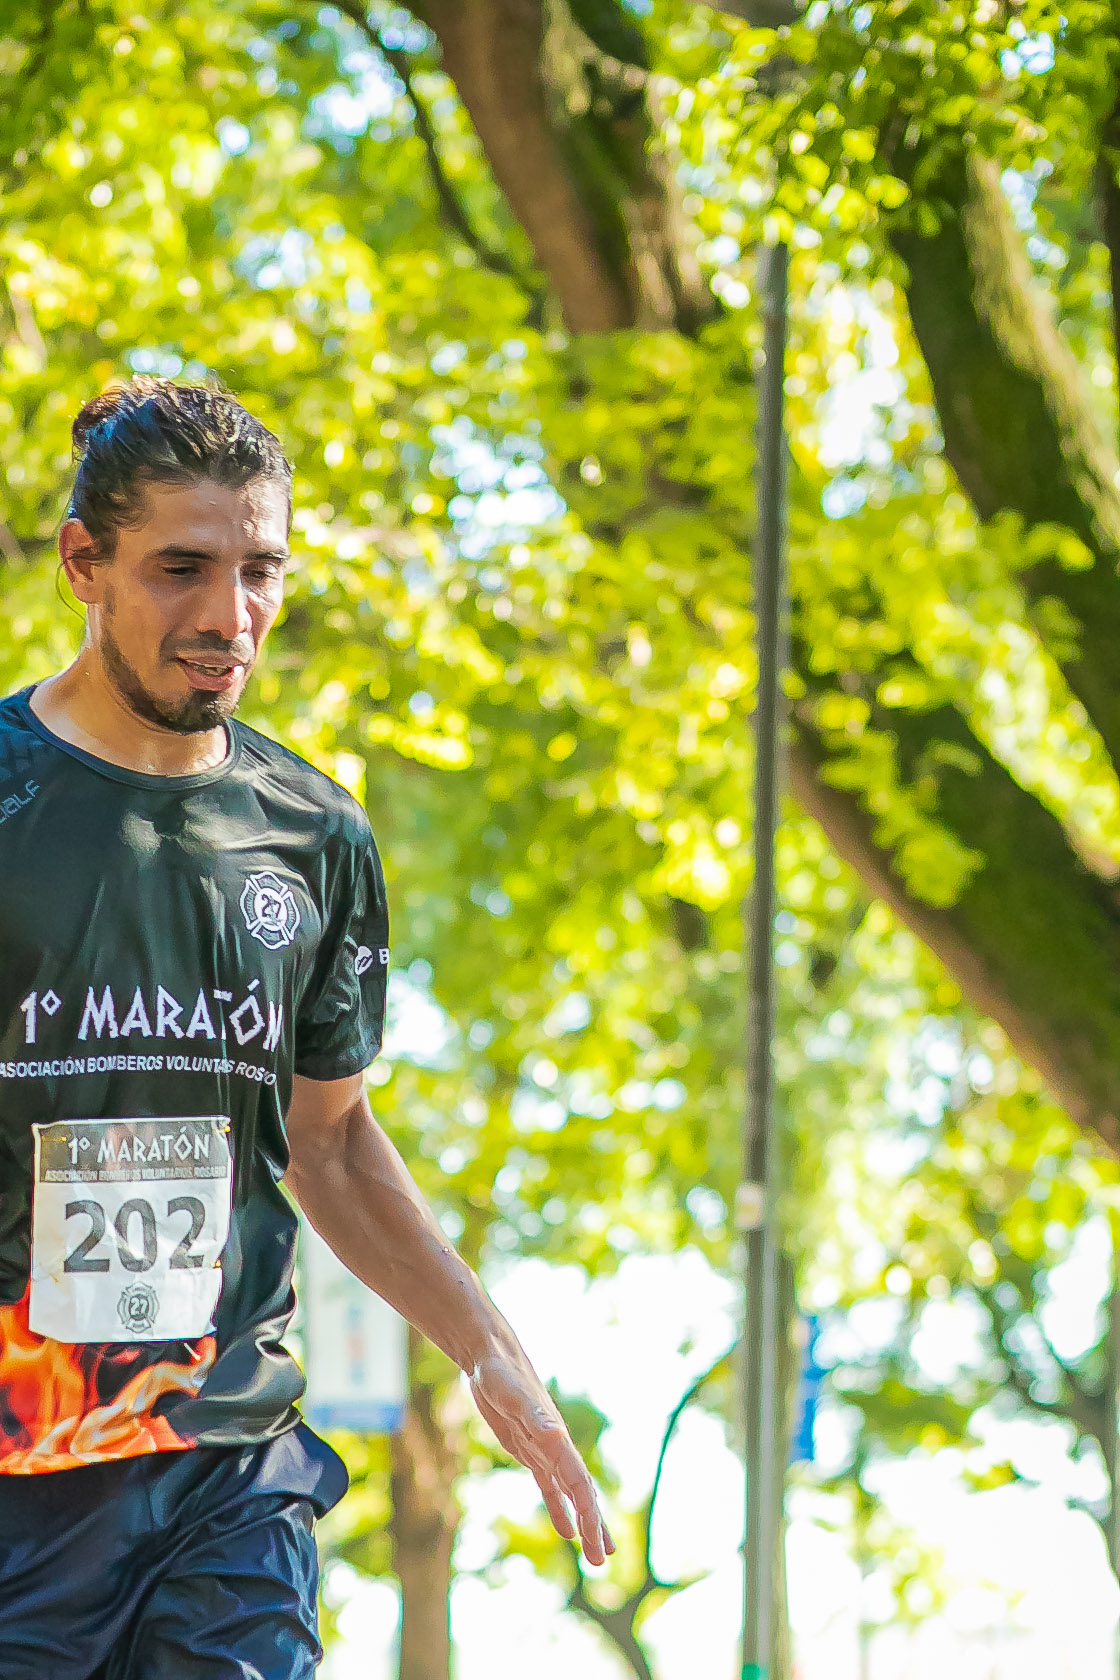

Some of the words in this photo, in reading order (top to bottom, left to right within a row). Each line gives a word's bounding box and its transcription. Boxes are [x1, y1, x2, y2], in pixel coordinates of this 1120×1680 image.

[77, 979, 283, 1053] MARATÓN
[86, 1054, 164, 1073] BOMBEROS
[97, 1125, 210, 1164] MARATÓN
[64, 1196, 205, 1273] 202
